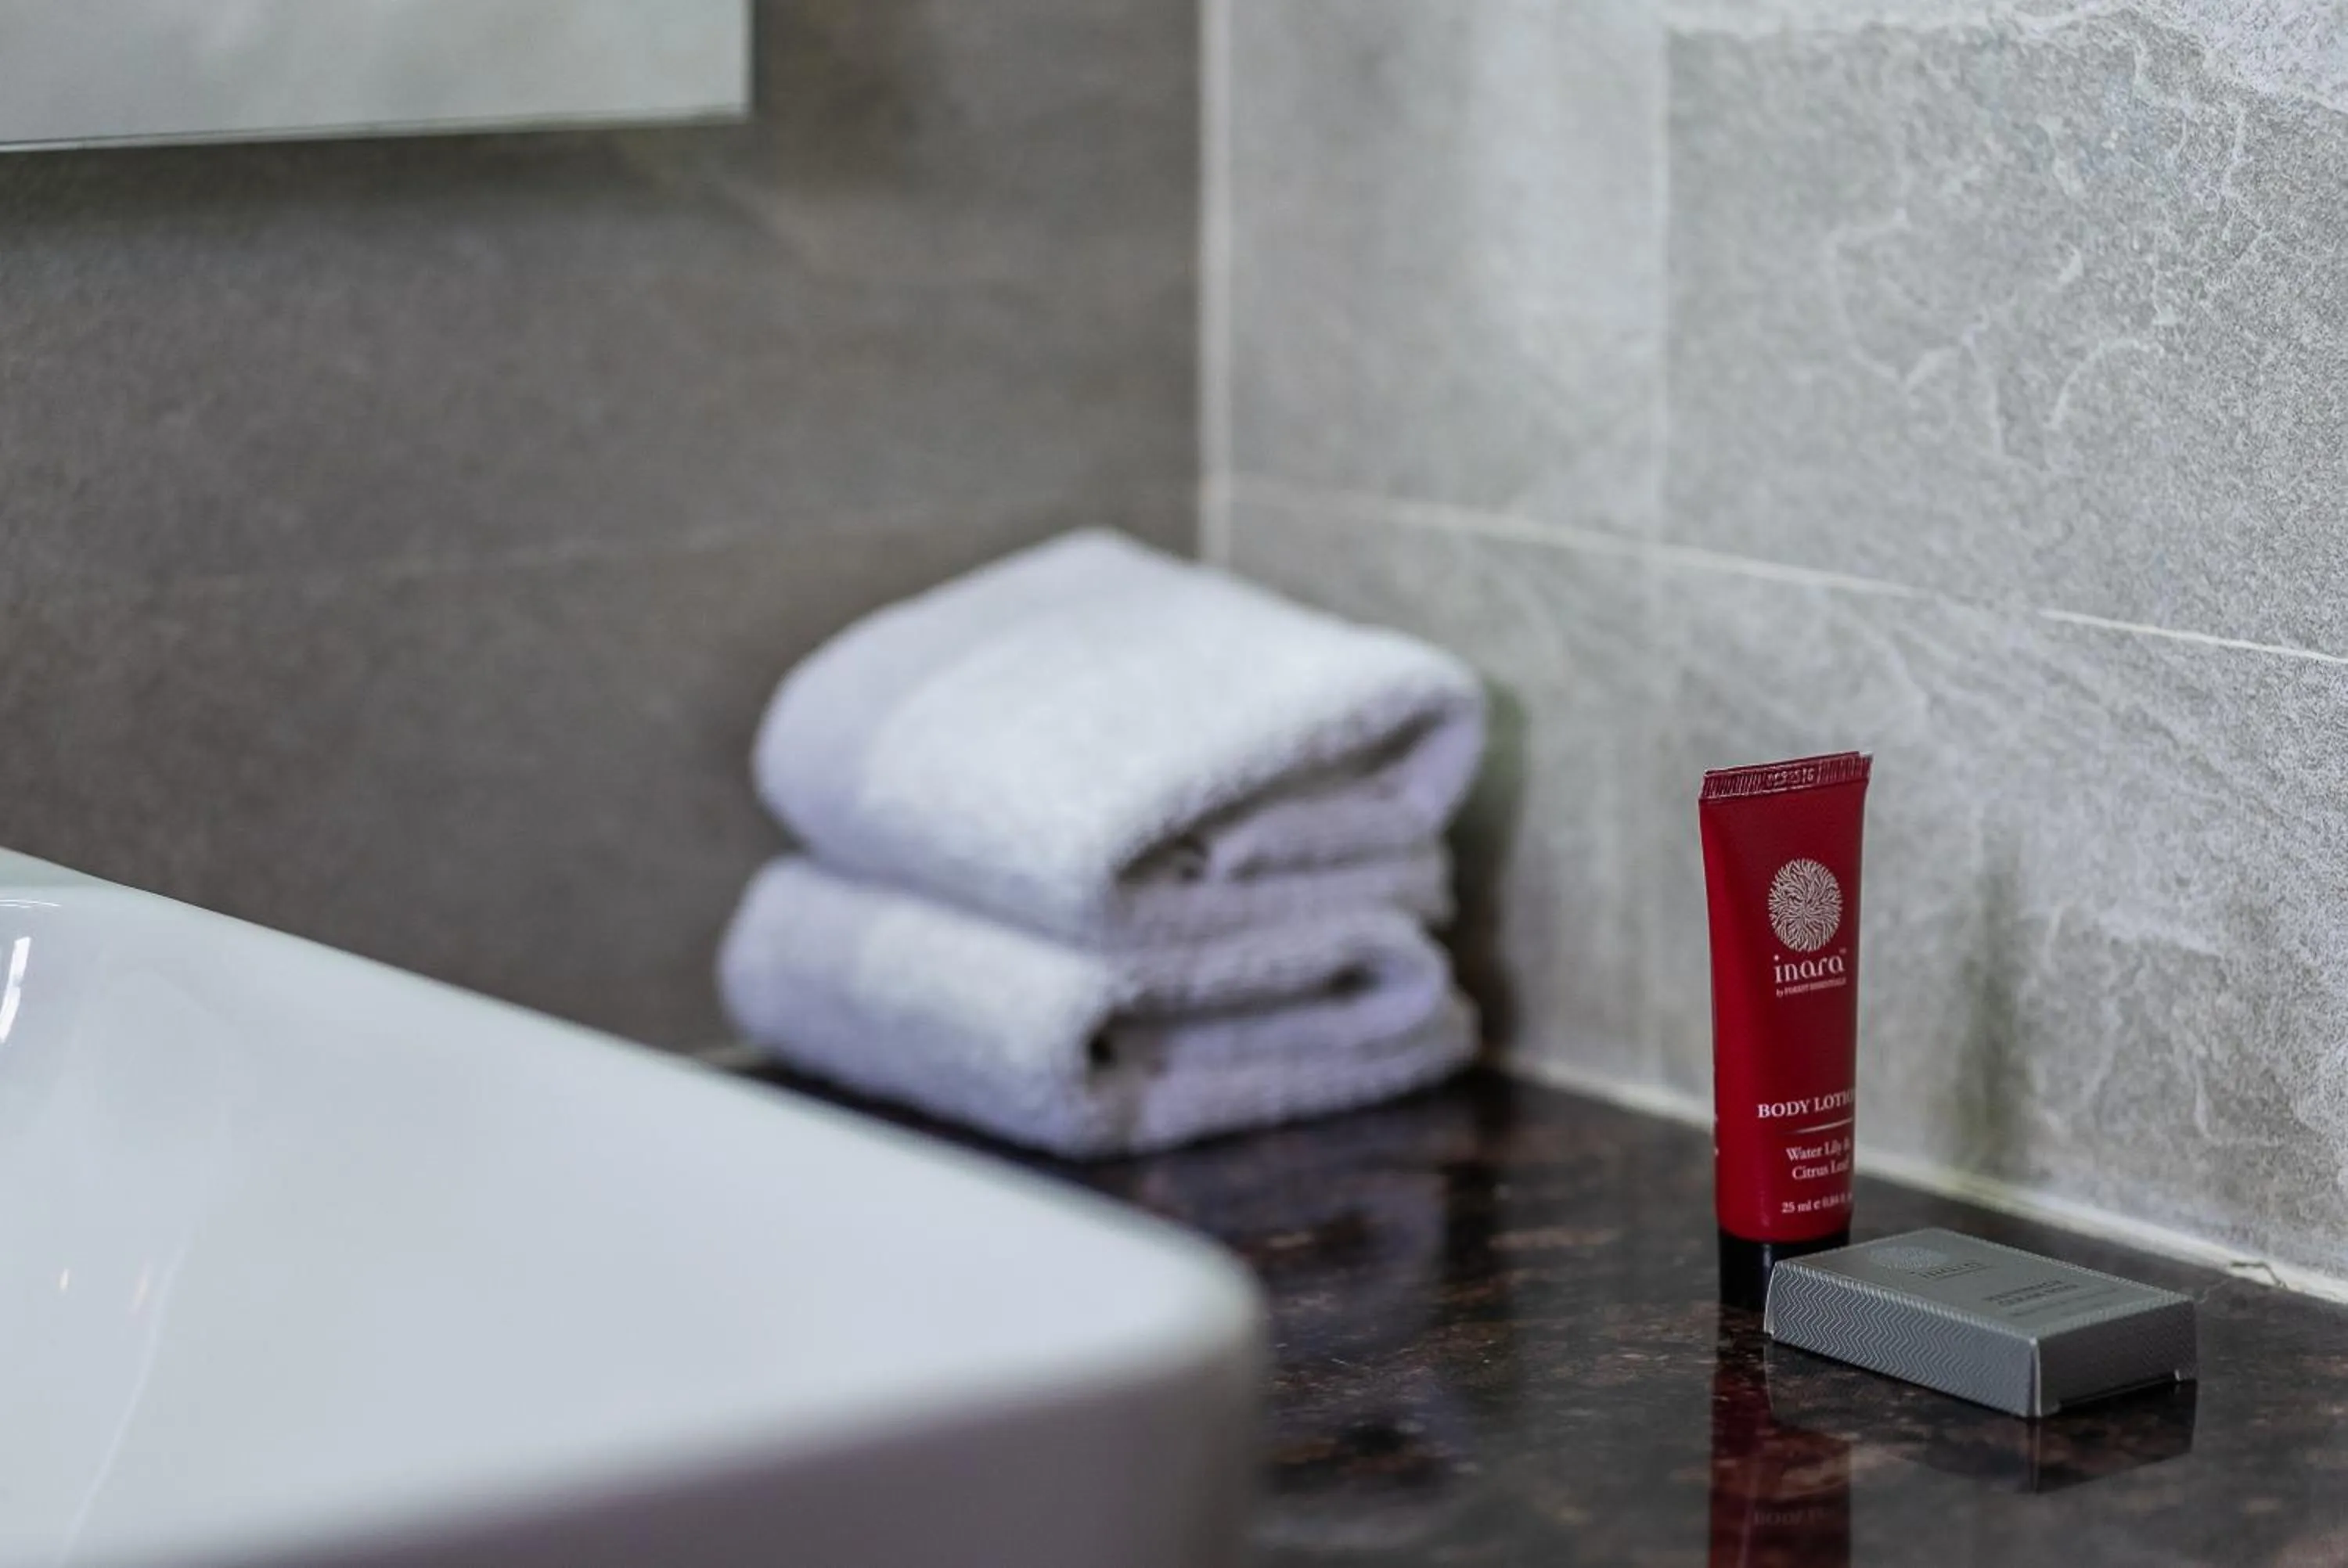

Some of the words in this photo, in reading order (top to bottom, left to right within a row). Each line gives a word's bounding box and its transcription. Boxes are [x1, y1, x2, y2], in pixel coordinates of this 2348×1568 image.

[1774, 955, 1844, 984] inara
[1757, 1099, 1810, 1118] BODY
[1786, 1146, 1823, 1161] Water
[1792, 1165, 1829, 1179] Citrus
[1781, 1201, 1795, 1214] 25
